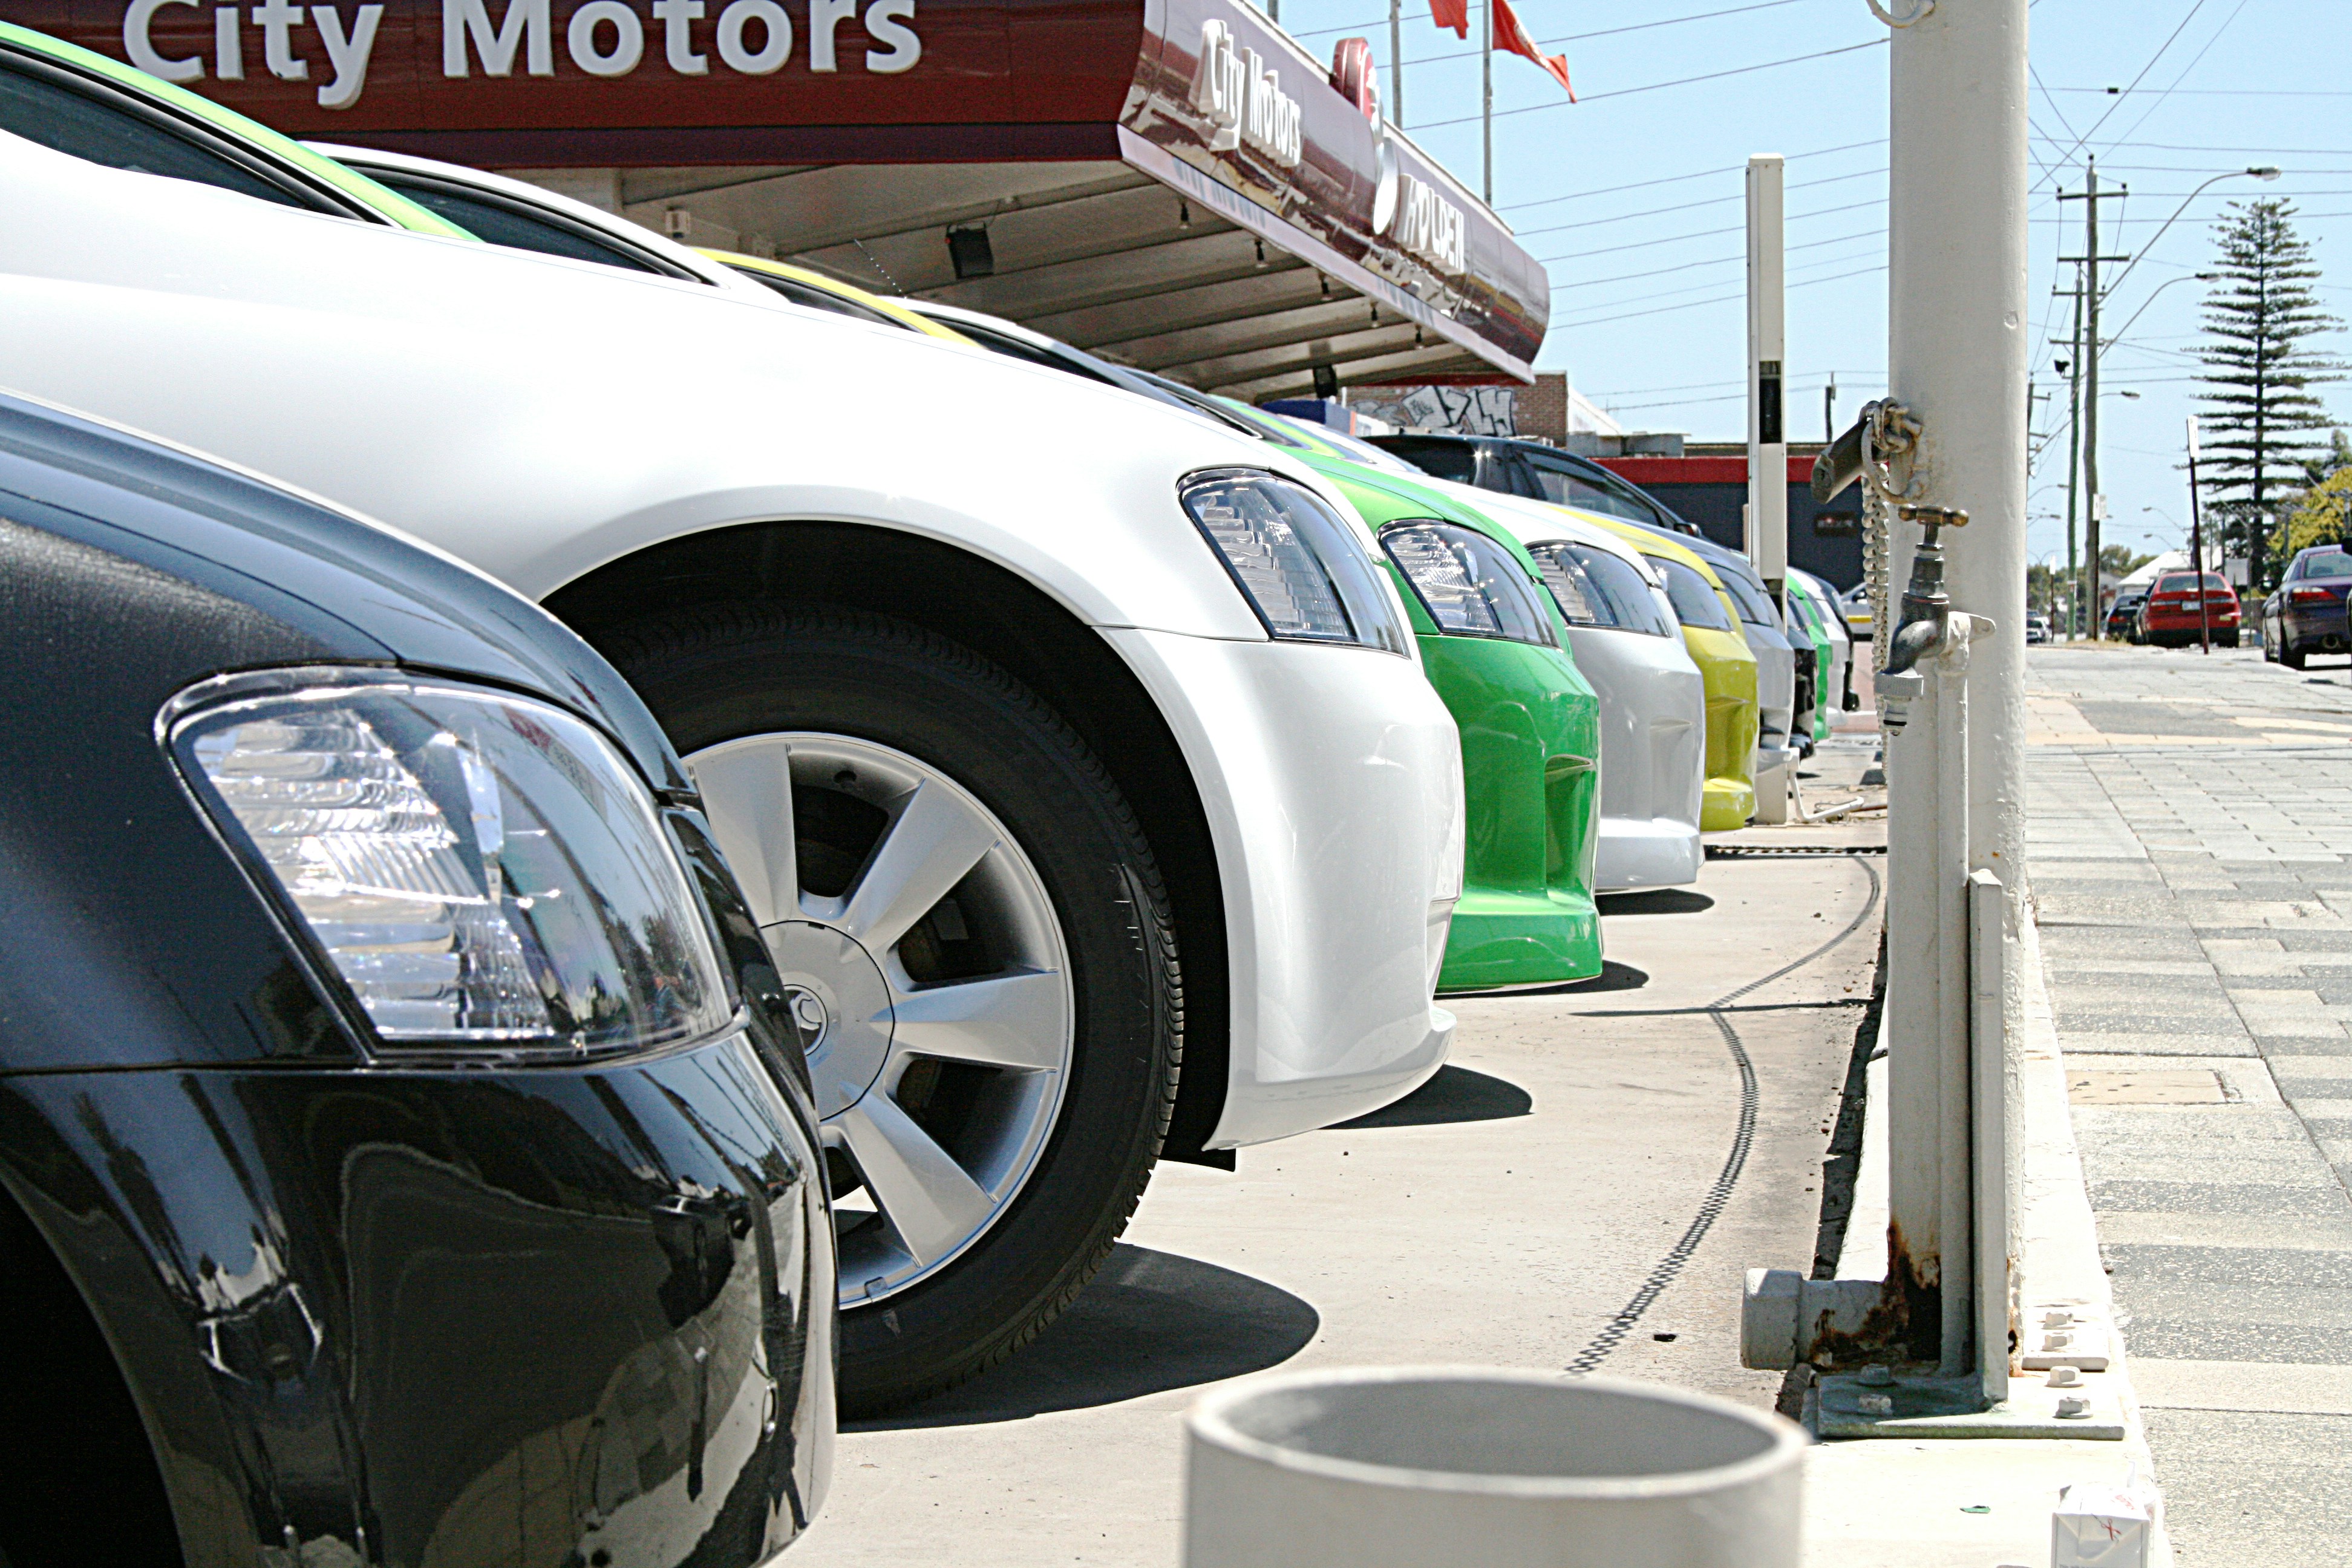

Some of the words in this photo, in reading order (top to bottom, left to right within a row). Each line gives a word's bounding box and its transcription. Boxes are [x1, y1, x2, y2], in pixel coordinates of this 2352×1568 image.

[123, 0, 384, 110] City
[442, 0, 922, 77] Motors
[1195, 19, 1245, 151] City
[1243, 47, 1301, 166] Motors
